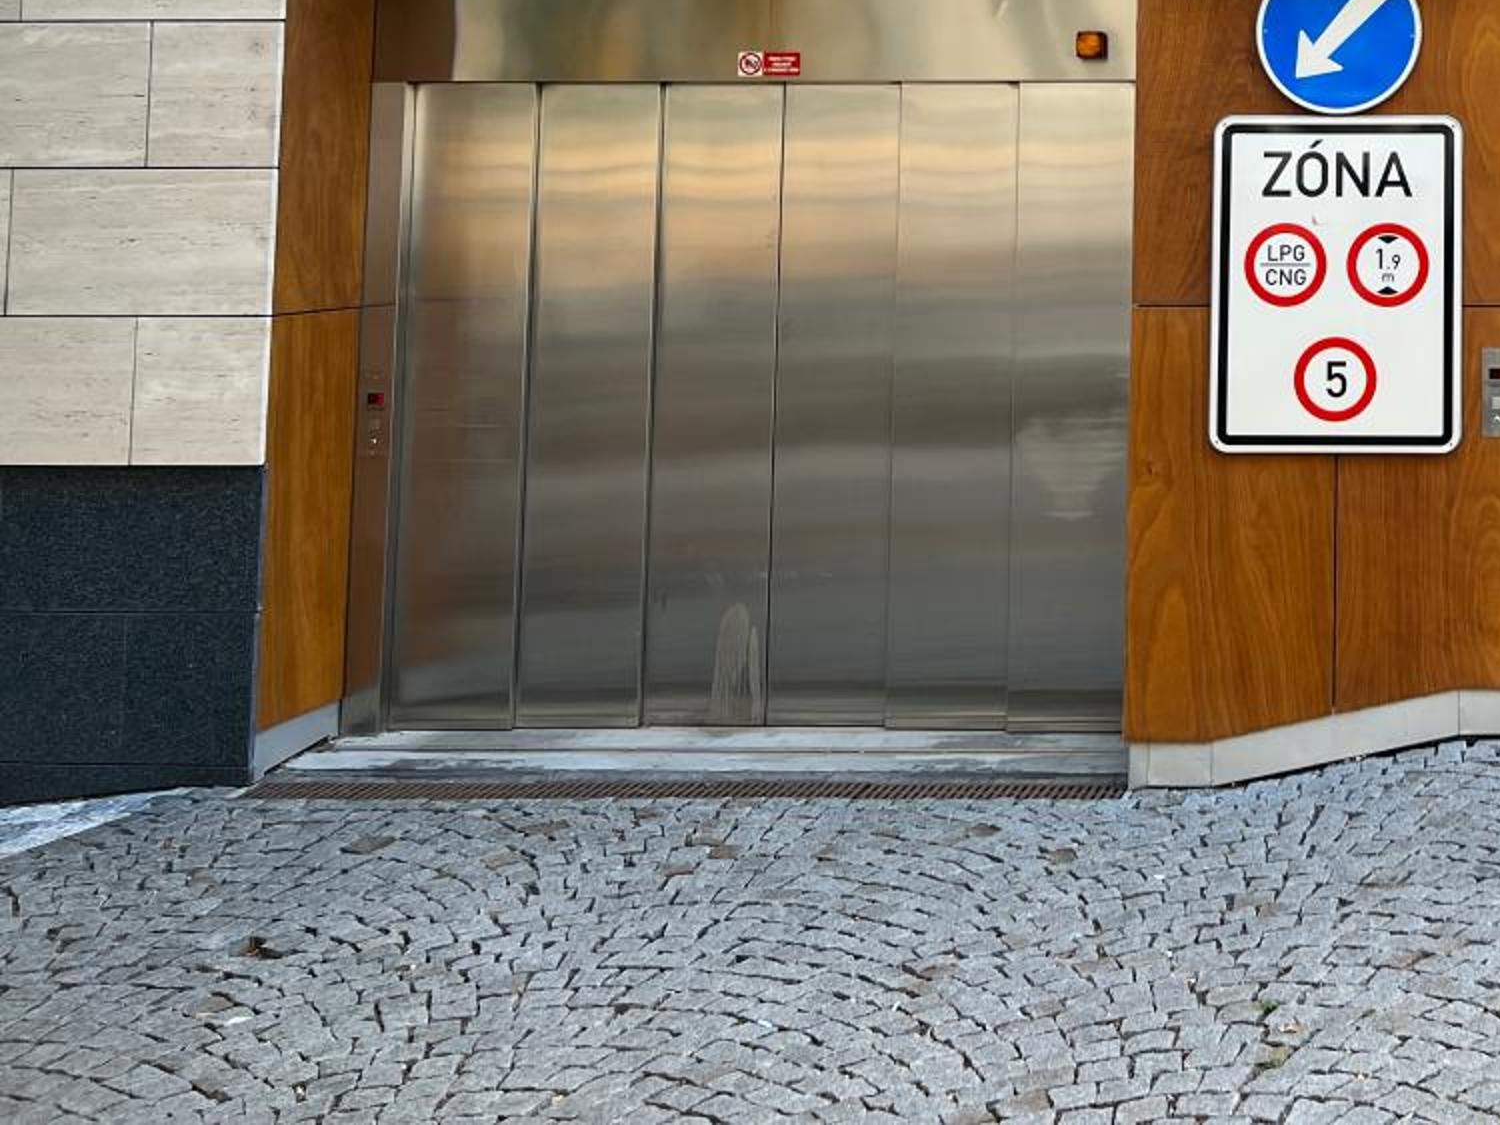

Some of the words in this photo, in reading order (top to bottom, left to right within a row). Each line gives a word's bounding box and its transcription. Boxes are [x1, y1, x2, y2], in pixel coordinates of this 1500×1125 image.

[1262, 139, 1413, 197] ZÓNA
[1267, 244, 1306, 262] LPG
[1265, 269, 1307, 286] CNG
[1381, 273, 1395, 283] m
[1325, 361, 1348, 398] 5
